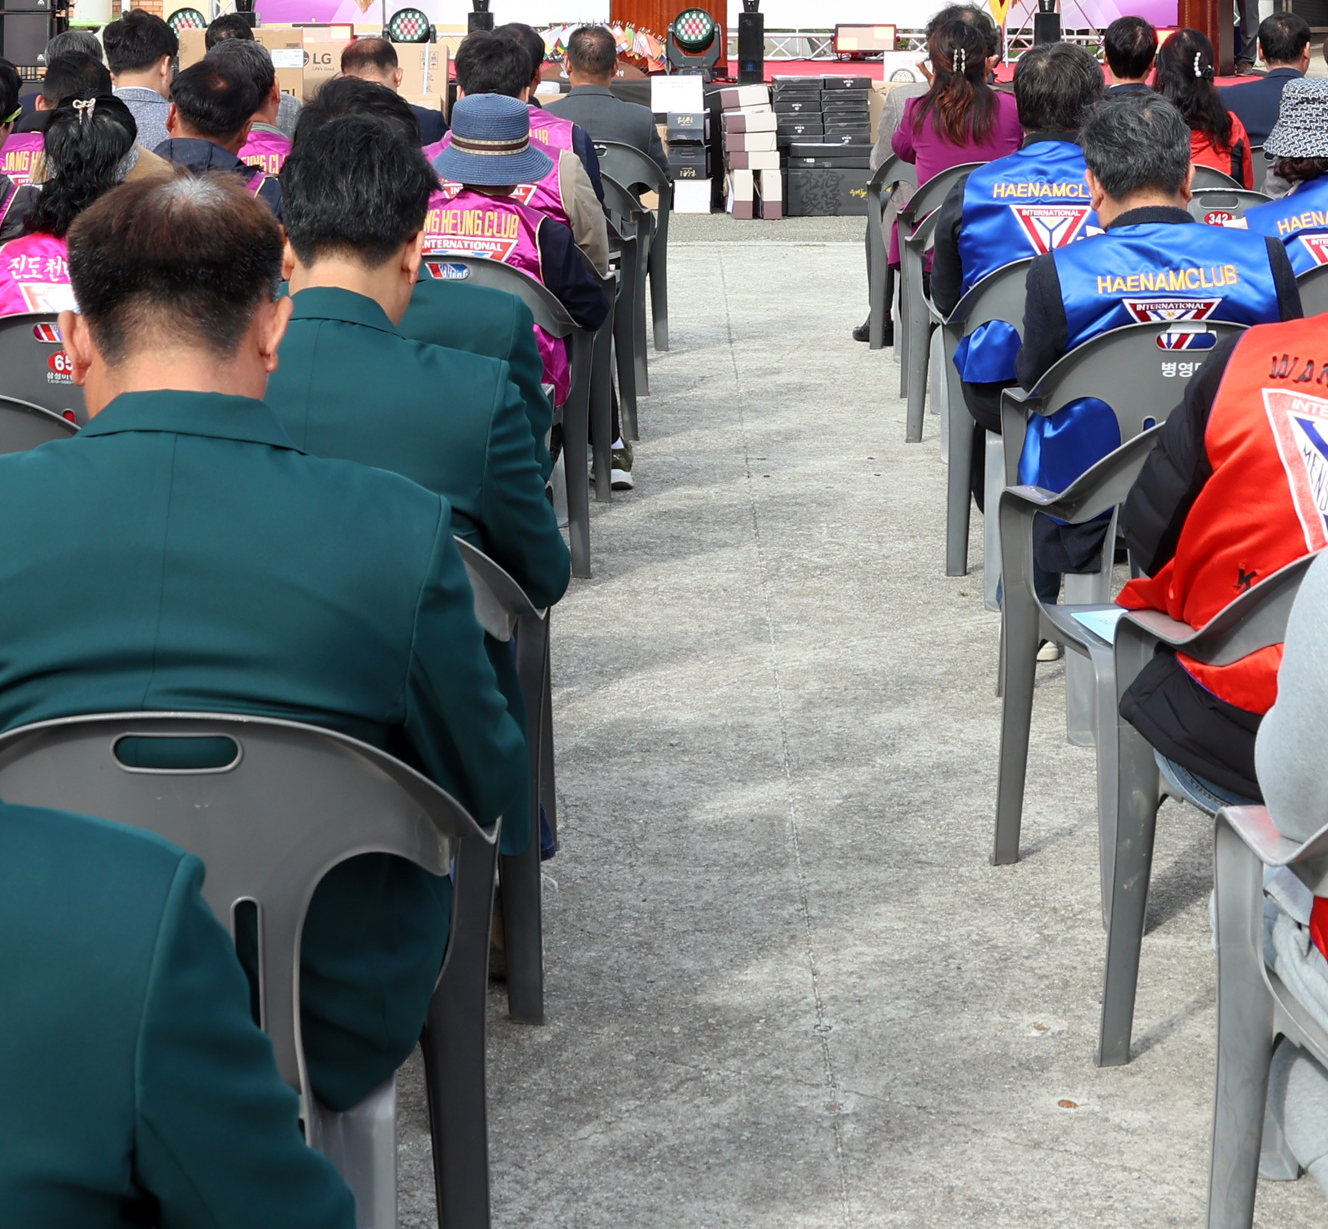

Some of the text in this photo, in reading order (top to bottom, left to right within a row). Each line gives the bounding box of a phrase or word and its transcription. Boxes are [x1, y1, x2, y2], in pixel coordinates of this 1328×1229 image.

[312, 52, 332, 65] LG
[1, 151, 29, 172] JANG
[1021, 208, 1081, 217] INTERNATIONAL
[1208, 213, 1229, 225] 342
[441, 209, 483, 236] HEUNG
[484, 210, 520, 238] CLUB
[422, 239, 503, 251] NTERNATIONAL
[7, 254, 70, 282] 진도천
[1097, 264, 1239, 294] HAENAMCLUB
[1136, 302, 1207, 311] INTERNATIONAL
[54, 354, 74, 371] 65
[46, 372, 73, 380] 삼성이
